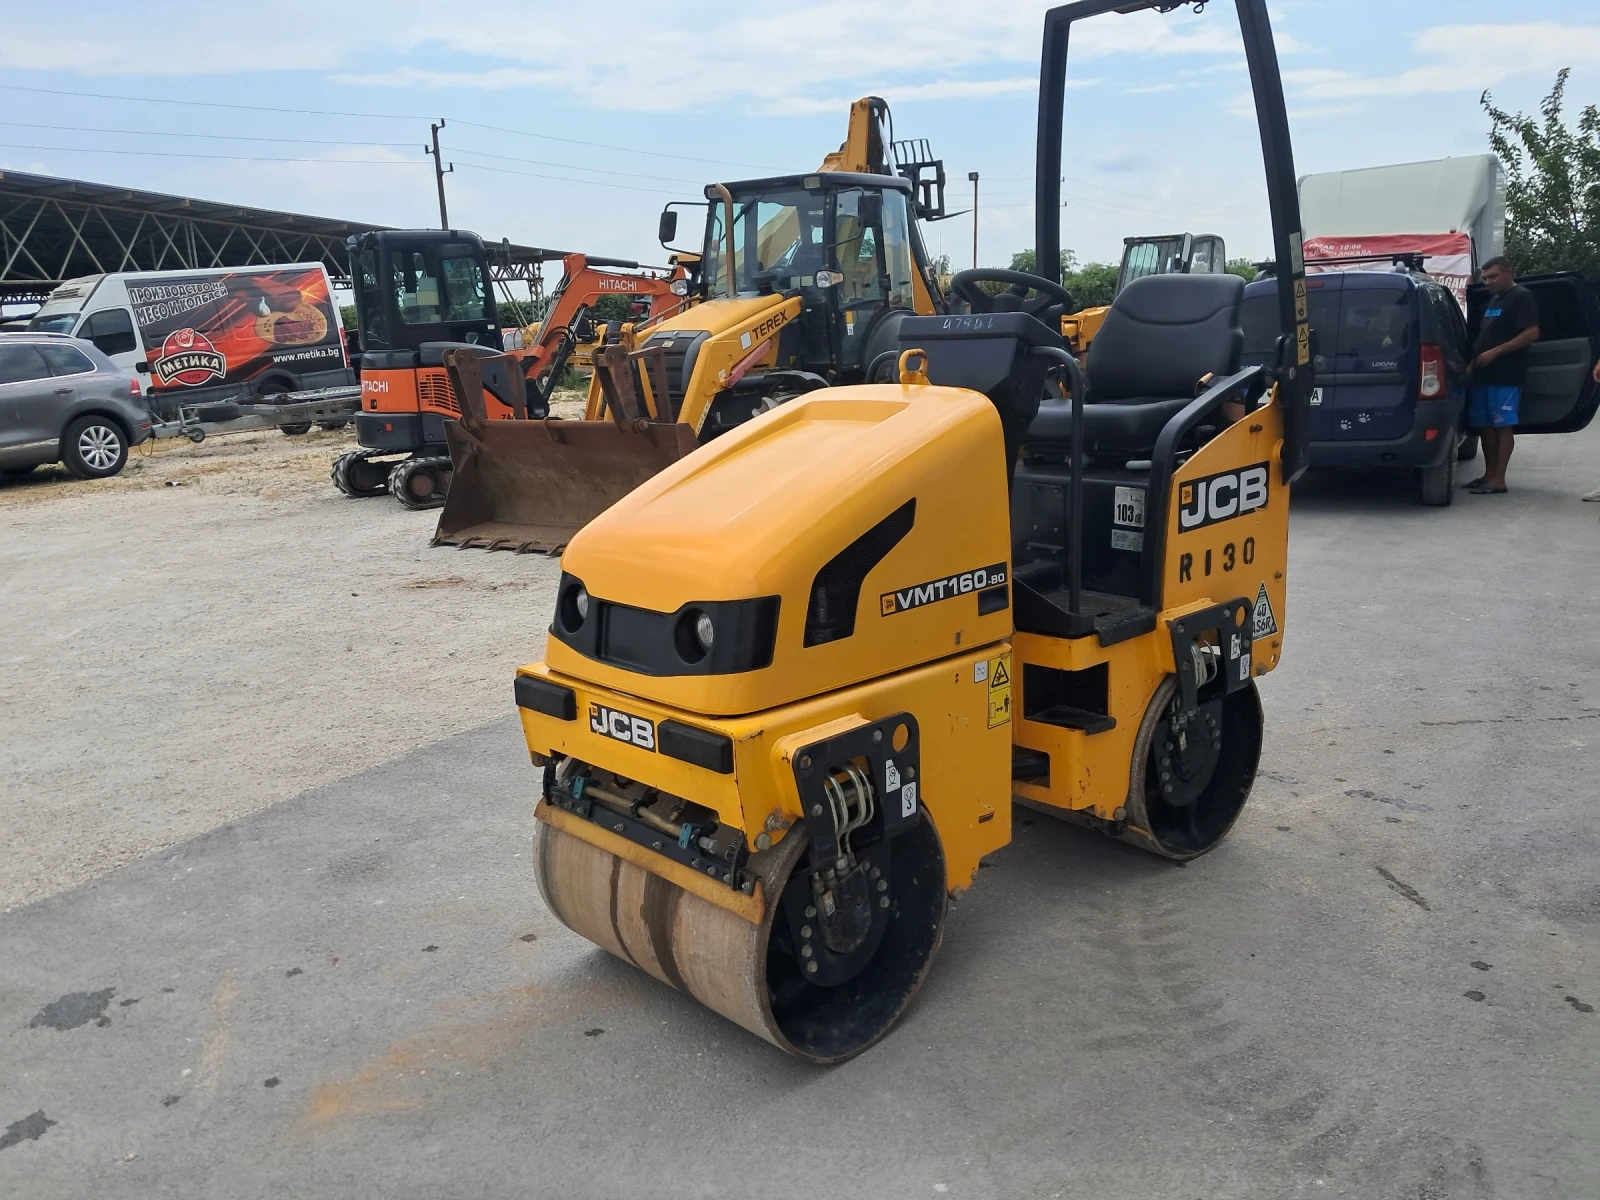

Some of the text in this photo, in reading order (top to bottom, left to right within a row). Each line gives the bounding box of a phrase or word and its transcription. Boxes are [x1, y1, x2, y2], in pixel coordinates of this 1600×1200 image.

[128, 281, 225, 304] ПРОИЗВОДСТВО НА
[599, 279, 637, 291] HITACHI
[134, 288, 229, 326] МЕСО И КОЛБАСИ
[752, 309, 788, 340] TEREX
[162, 356, 219, 375] МЕТИКА
[273, 348, 339, 363] www.metika.bg
[1181, 467, 1267, 527] JCB
[1117, 503, 1134, 522] 103
[591, 708, 655, 749] JCB
